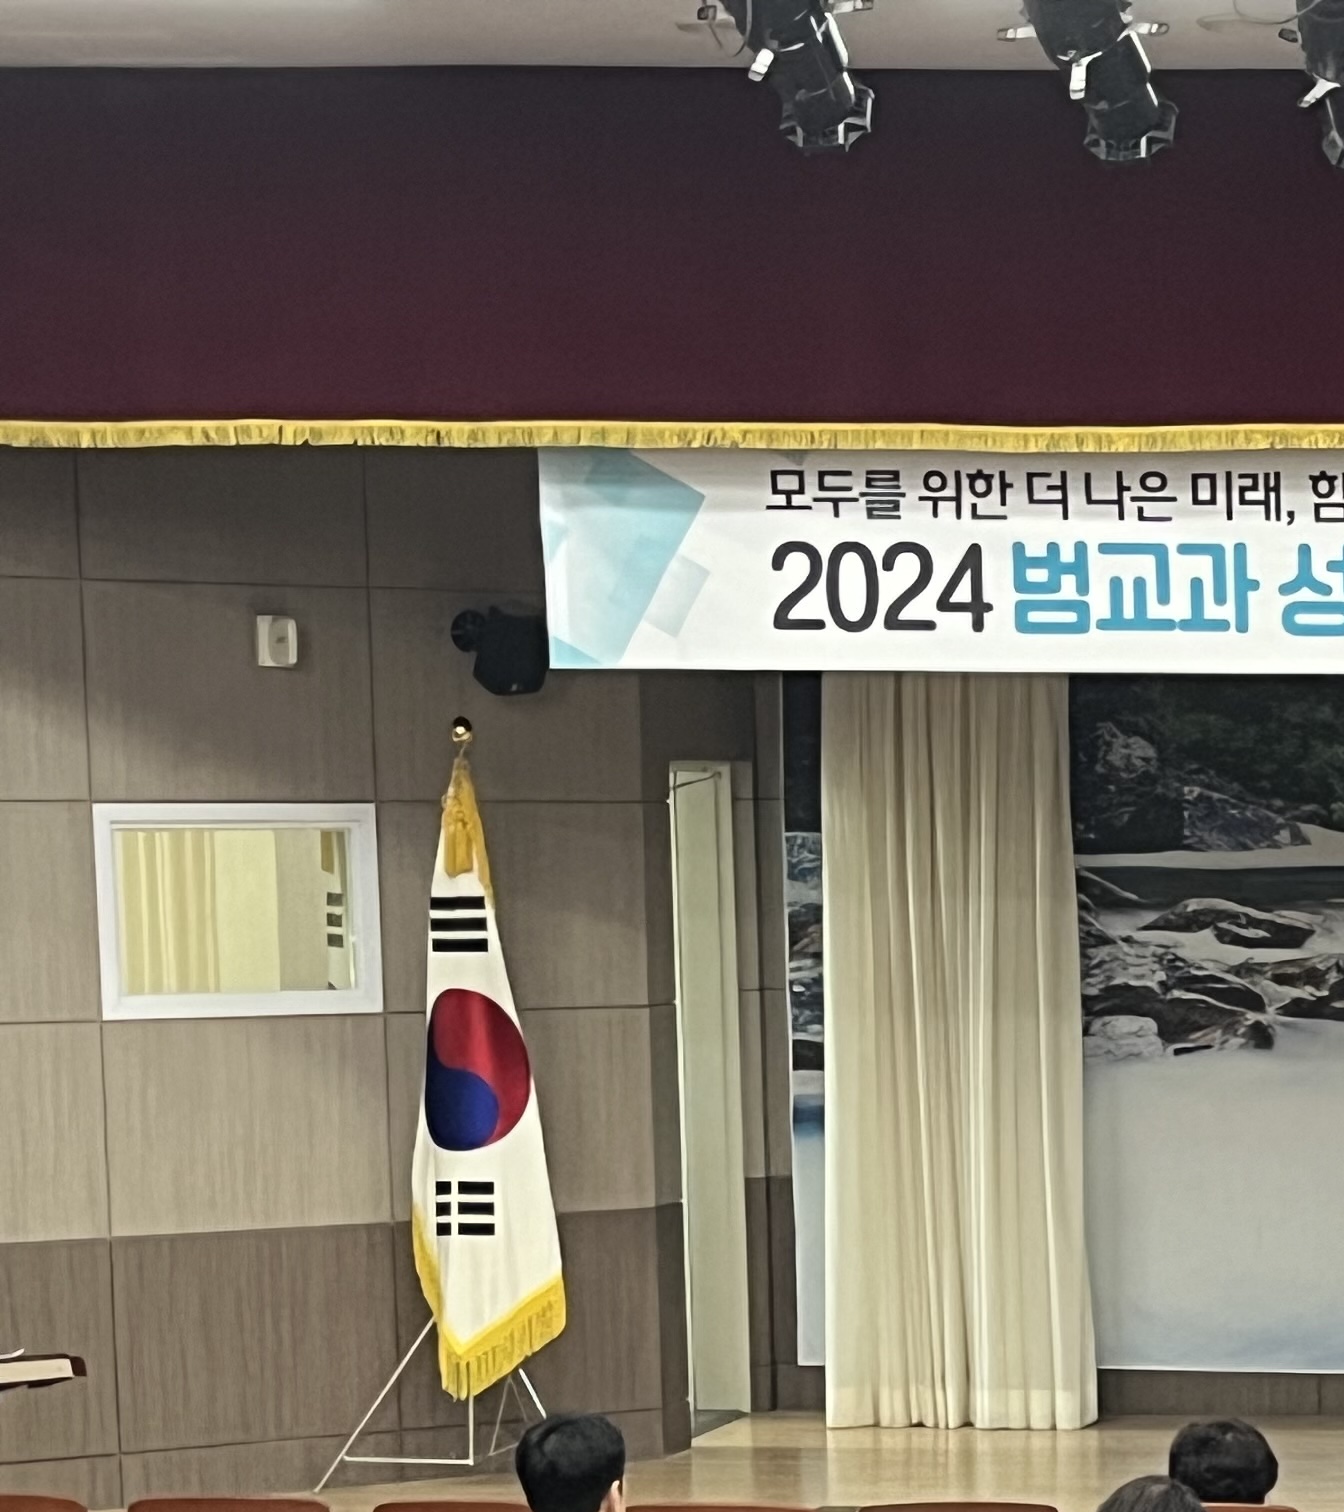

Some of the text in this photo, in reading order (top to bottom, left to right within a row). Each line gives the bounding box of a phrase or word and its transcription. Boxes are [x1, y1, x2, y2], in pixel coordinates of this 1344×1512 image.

[765, 468, 907, 521] 모두를
[918, 468, 1014, 520] 위한
[1025, 469, 1069, 521] 더
[1083, 470, 1178, 522] 나은
[1190, 470, 1295, 526] 미래,
[771, 540, 994, 633] 2024
[1013, 543, 1259, 634] 범교과
